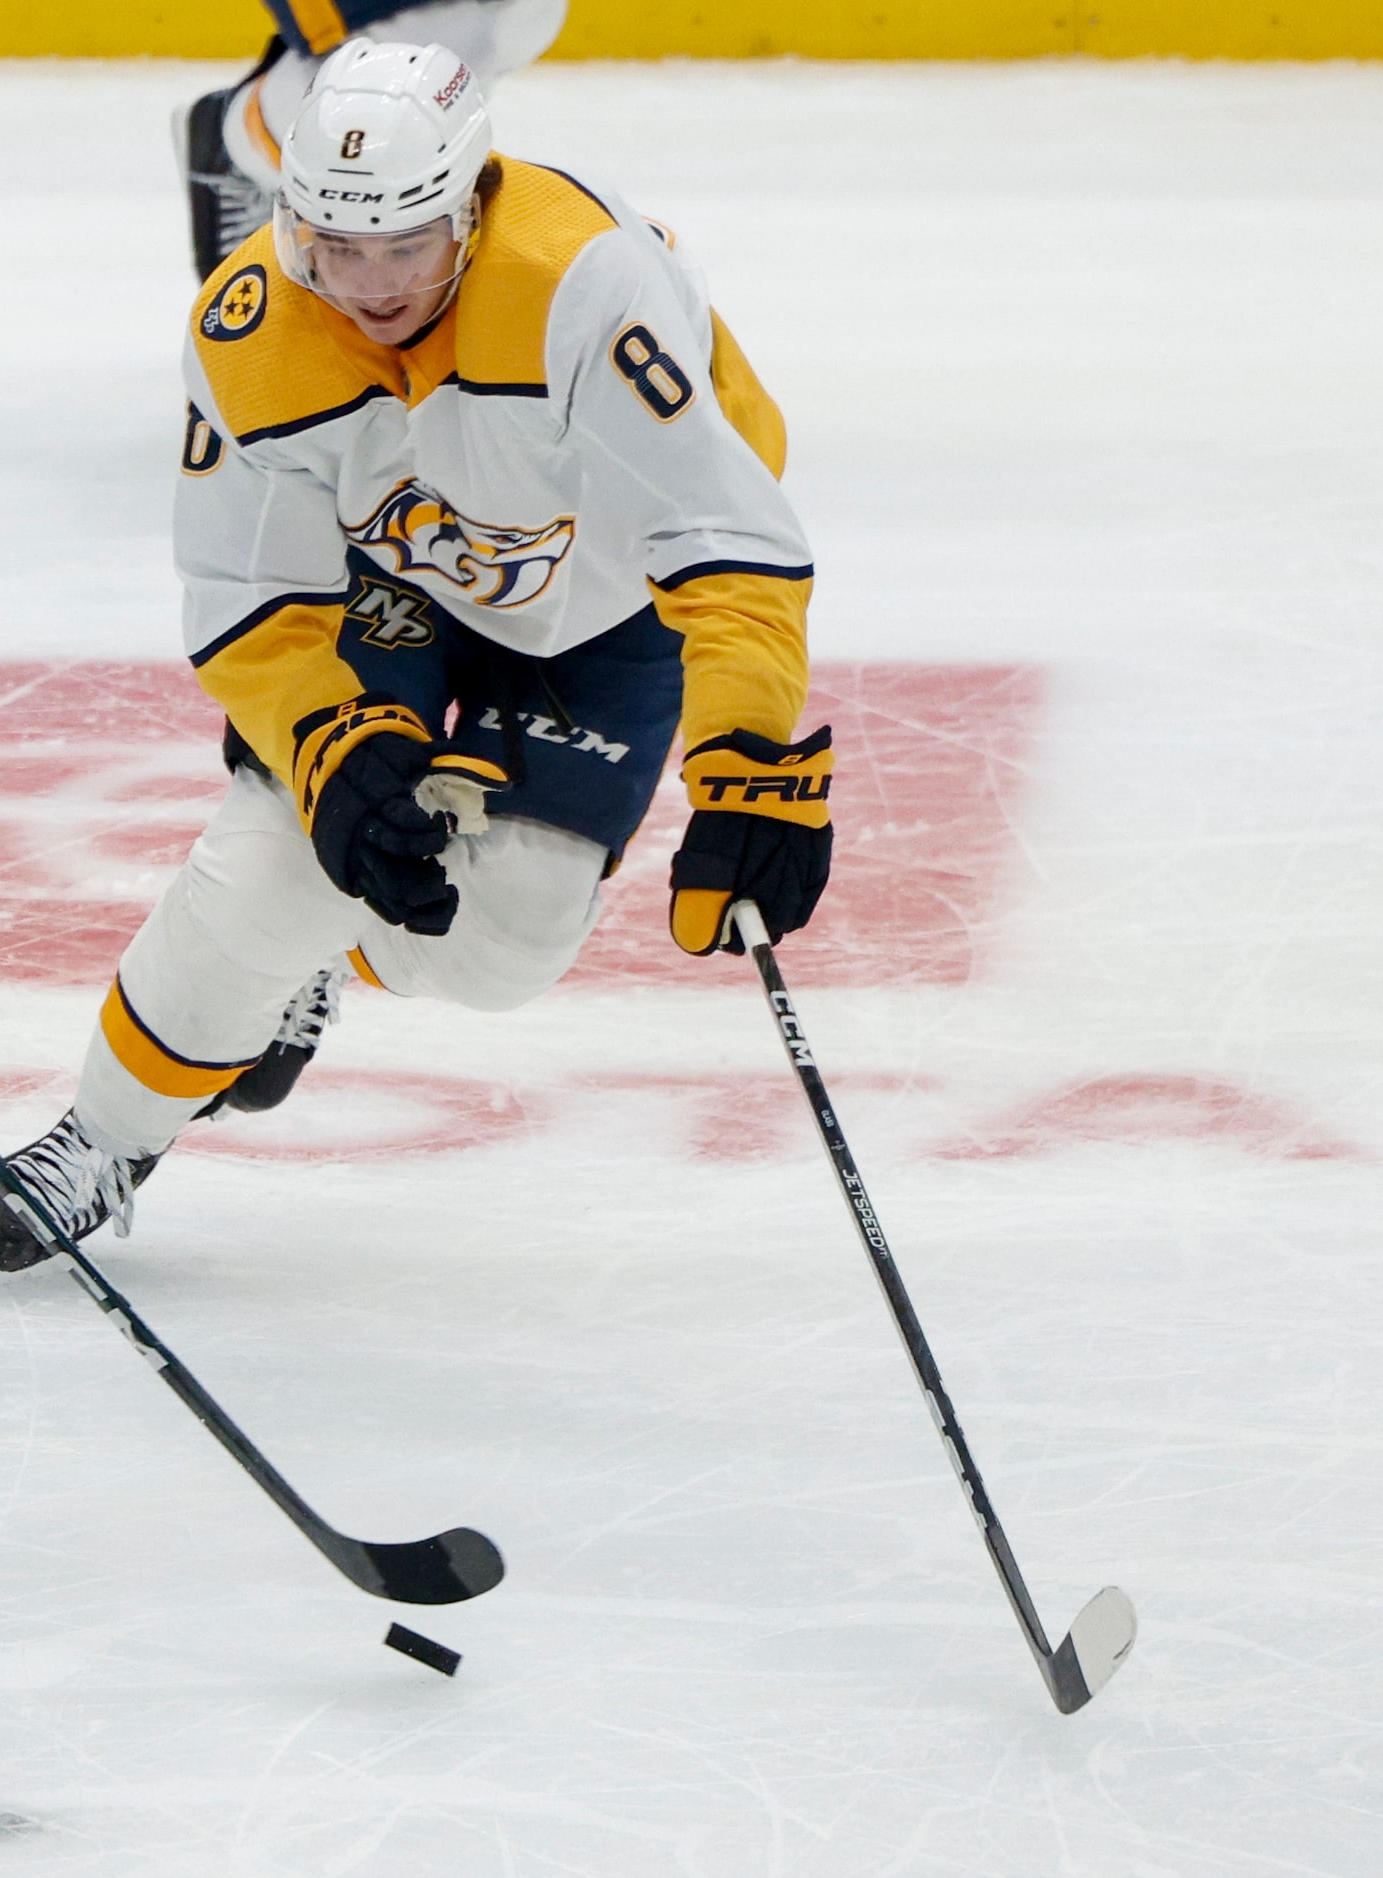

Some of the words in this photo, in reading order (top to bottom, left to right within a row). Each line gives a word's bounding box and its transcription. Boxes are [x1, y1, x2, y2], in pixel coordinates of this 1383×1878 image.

[340, 130, 366, 159] 8
[318, 188, 385, 204] CCM
[607, 320, 697, 425] 8
[478, 706, 630, 764] CCM
[699, 774, 832, 802] TRU
[770, 990, 815, 1067] CCM
[841, 1168, 886, 1248] JETSPEED
